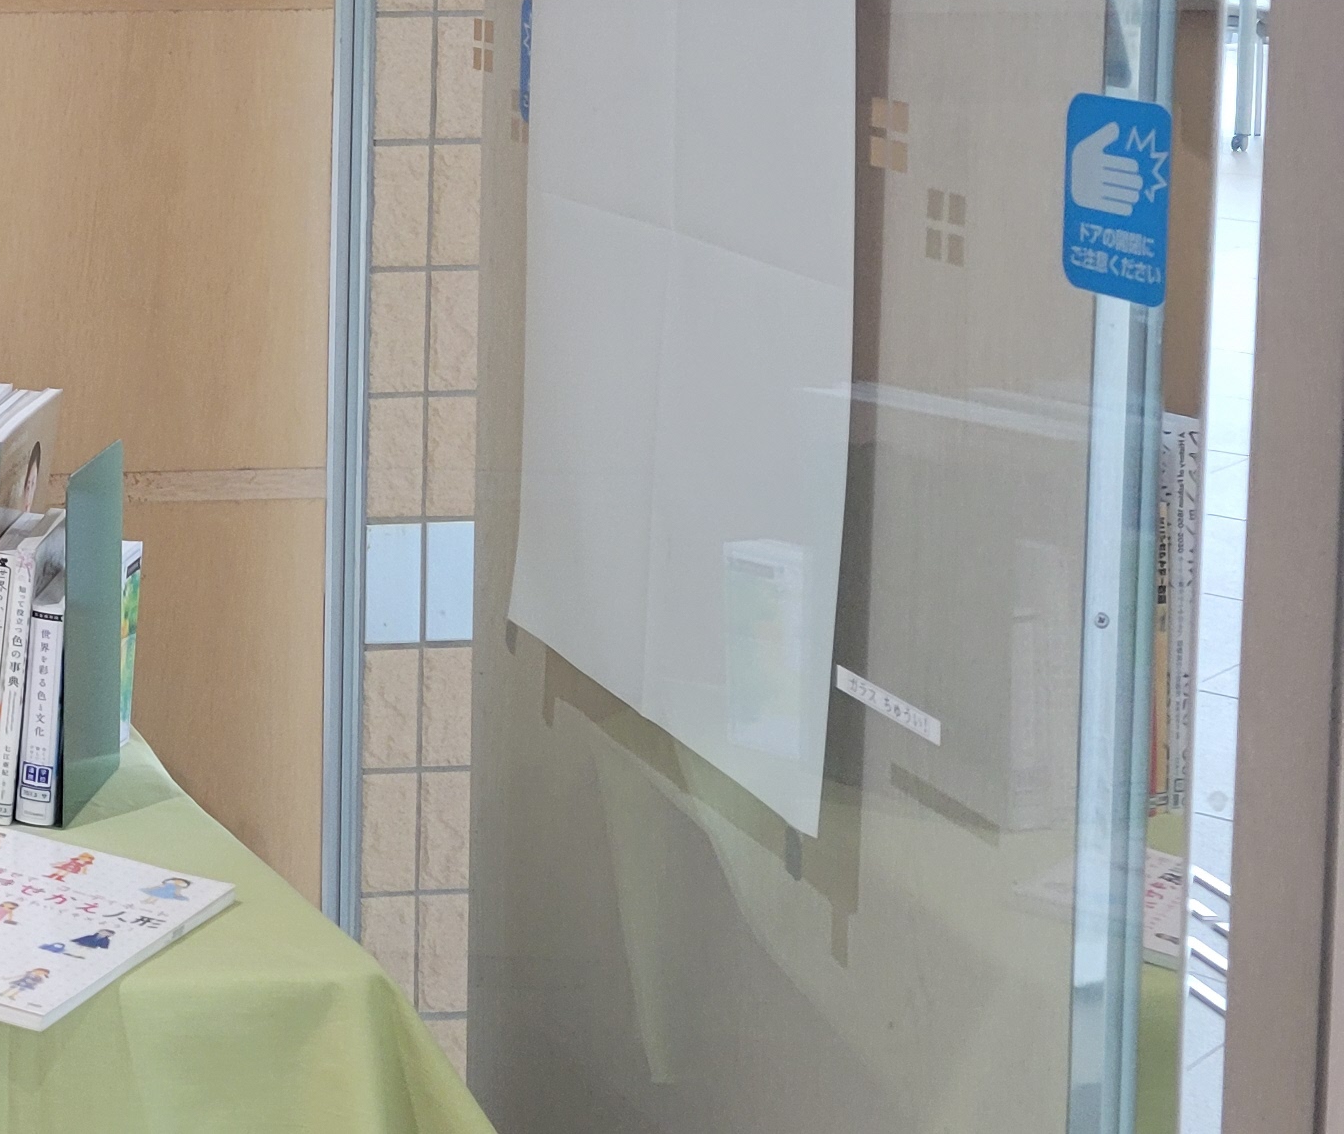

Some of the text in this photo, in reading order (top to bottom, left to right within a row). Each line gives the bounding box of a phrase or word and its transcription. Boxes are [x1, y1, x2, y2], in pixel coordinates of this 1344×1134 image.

[1069, 245, 1162, 284] ご注意ください
[7, 585, 27, 688] 知って役立つ 色の事典
